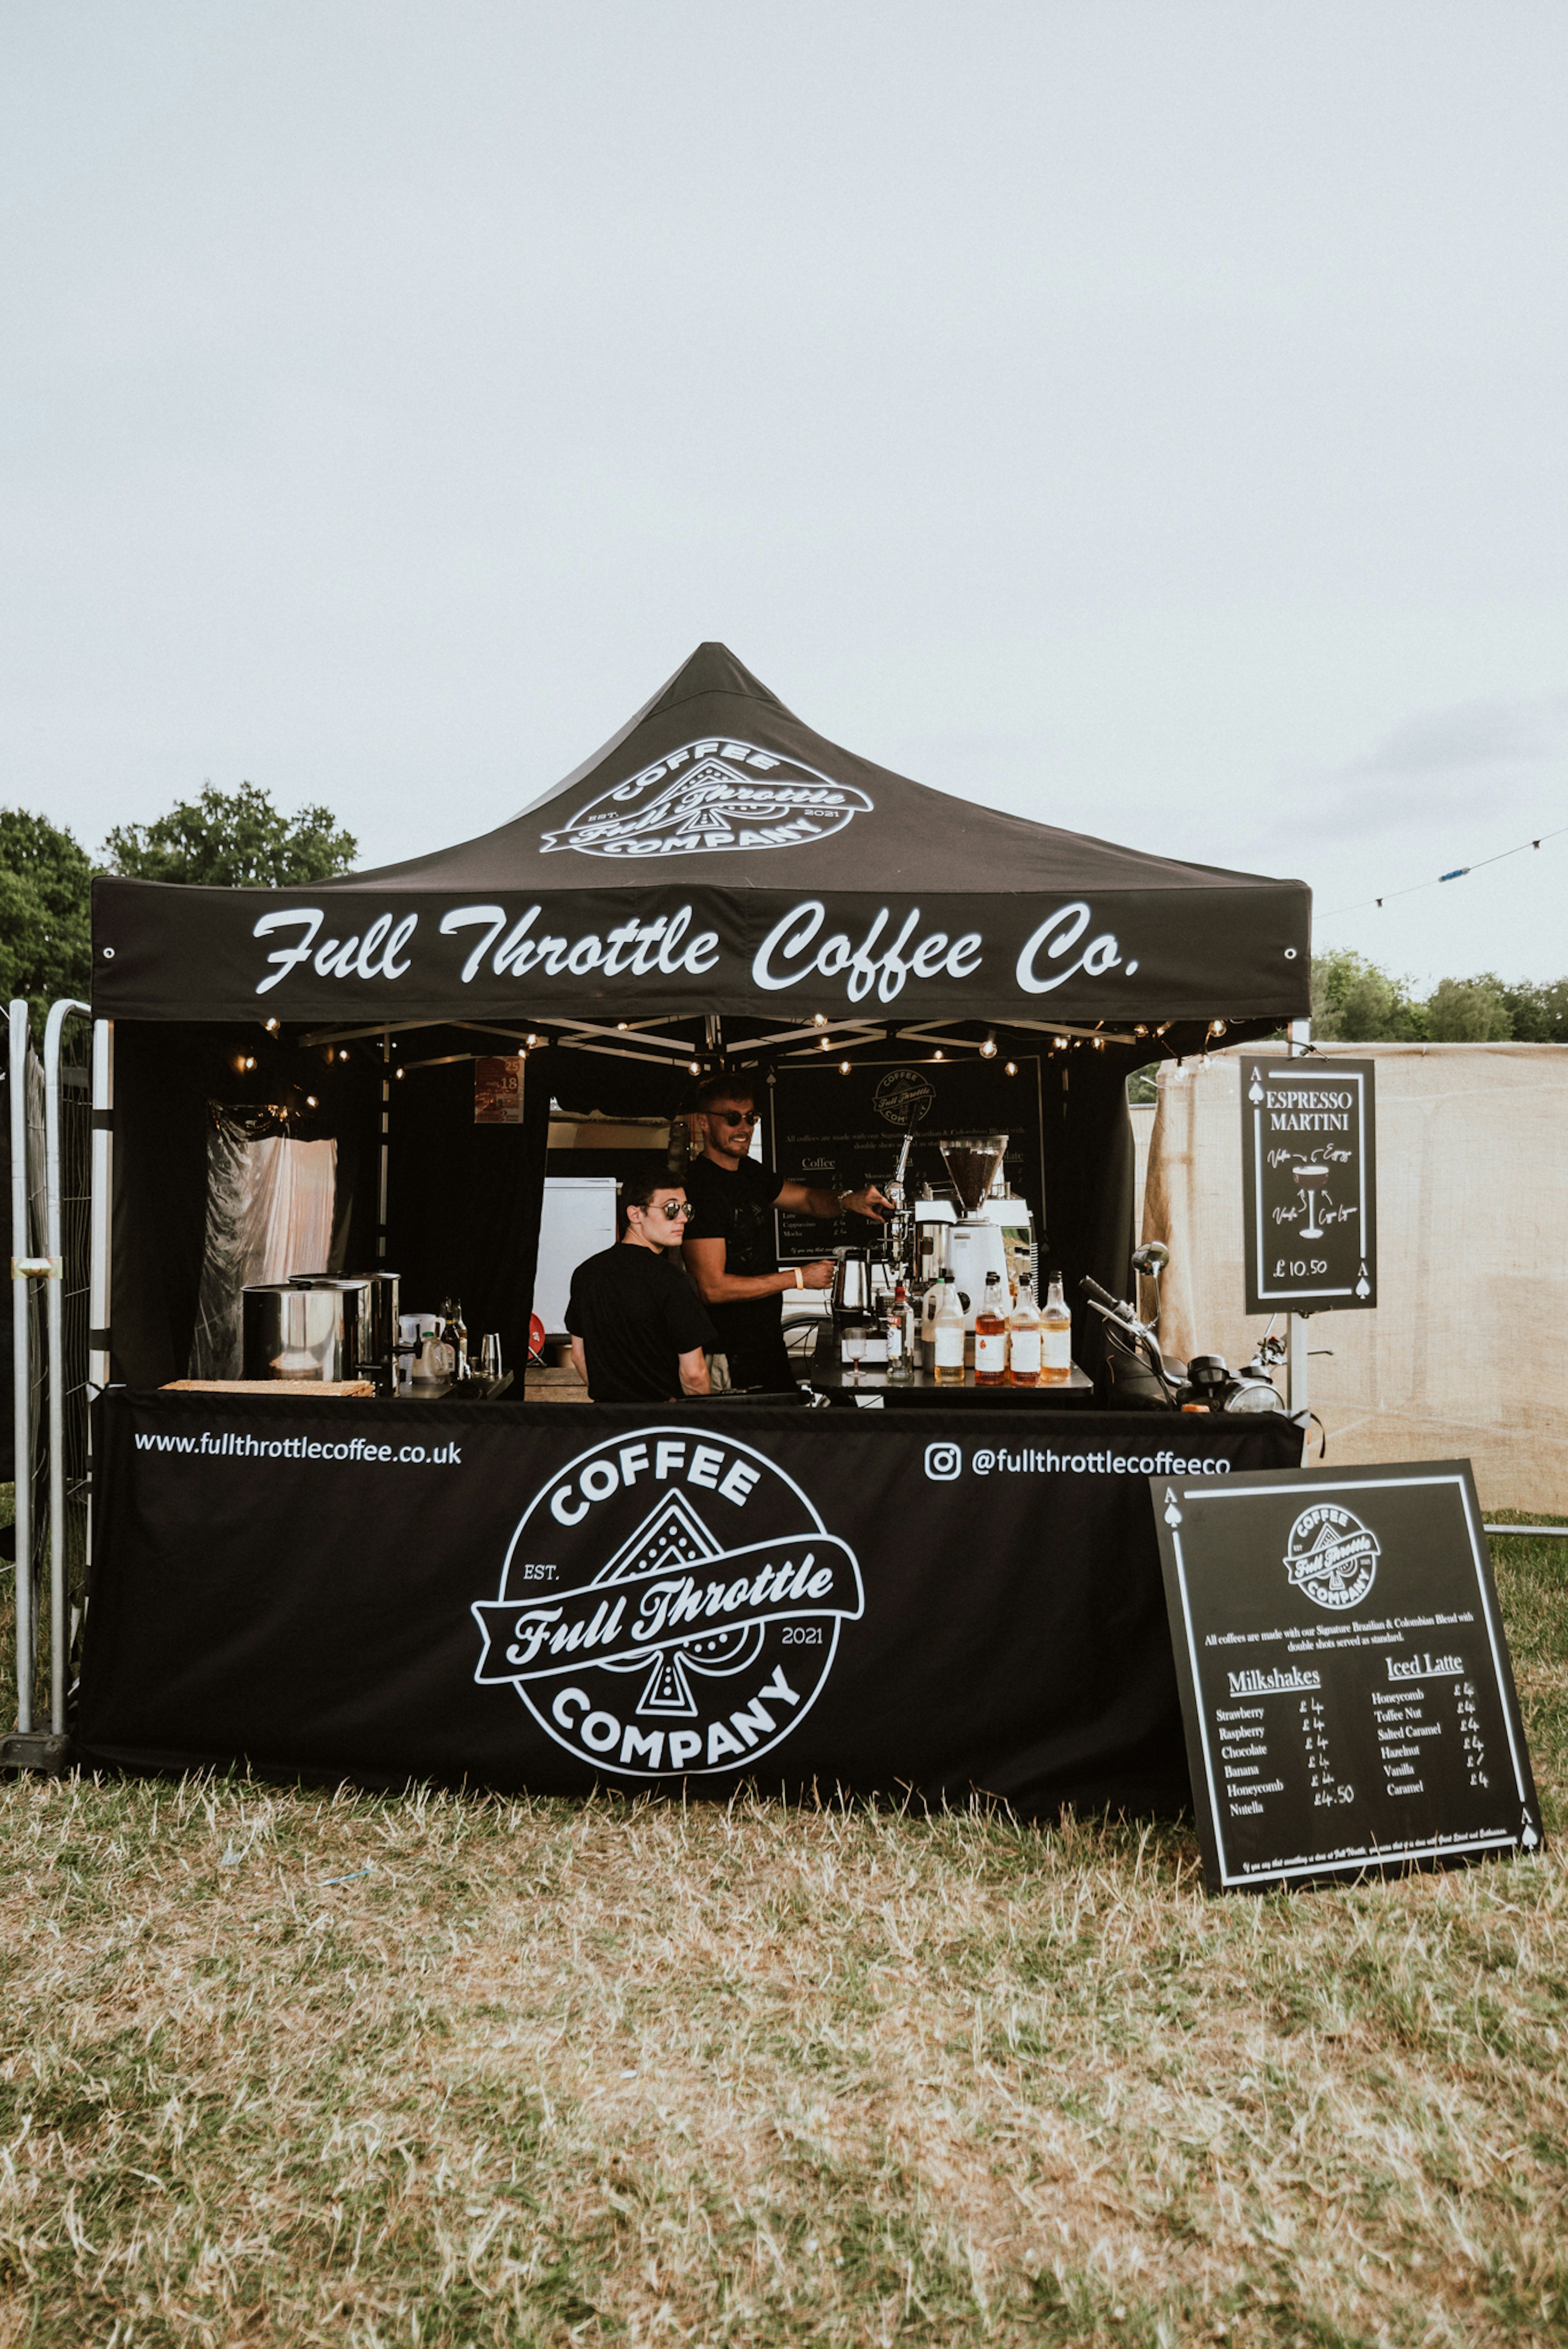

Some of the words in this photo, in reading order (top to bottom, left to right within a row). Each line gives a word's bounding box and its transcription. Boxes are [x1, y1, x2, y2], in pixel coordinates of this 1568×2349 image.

[612, 743, 780, 802] COFFEE
[569, 802, 672, 844] Full
[675, 784, 846, 813] Throttle
[588, 812, 619, 822] EST.
[804, 809, 840, 817] 2021
[604, 817, 822, 855] COMPANY
[253, 908, 418, 994] Full
[439, 906, 720, 984] Throttle
[751, 900, 982, 1003] Coffee
[1016, 902, 1139, 995] Co.
[883, 1072, 918, 1087] COFFEE
[1250, 1066, 1262, 1081] A
[501, 1078, 517, 1089] 18
[1266, 1091, 1352, 1109] ESPRESSO
[1270, 1113, 1349, 1131] MARTINI
[802, 1156, 836, 1168] Coffee
[1358, 1261, 1369, 1276] A
[134, 1432, 462, 1465] www.fullthrottlecoffee.co.uk
[972, 1448, 1231, 1475] @fullthrottlecoffeeco
[550, 1441, 761, 1526] COFFEE
[1164, 1486, 1178, 1503] A
[1297, 1509, 1348, 1537] COFFEE
[1294, 1554, 1323, 1579] Full
[1324, 1535, 1371, 1567] Throttle
[523, 1564, 559, 1581] EST.
[1307, 1567, 1370, 1605] COMPANY
[506, 1596, 627, 1665] Full
[630, 1553, 834, 1641] Throttle
[782, 1627, 823, 1644] 2021
[1205, 1634, 1217, 1646] All
[1218, 1632, 1246, 1645] coffees
[1247, 1633, 1259, 1642] are
[1261, 1628, 1282, 1641] made
[1283, 1627, 1301, 1639] with
[1301, 1628, 1316, 1637] our
[1316, 1624, 1351, 1637] Signature
[1352, 1620, 1385, 1633] Brazilian
[1386, 1618, 1393, 1630] &
[1394, 1616, 1434, 1628] Colombian
[1435, 1612, 1457, 1625] Blend
[1458, 1611, 1474, 1622] with
[1287, 1639, 1314, 1652] double
[1316, 1638, 1335, 1649] shots
[1336, 1635, 1360, 1648] served
[1361, 1637, 1370, 1645] as
[1385, 1654, 1421, 1677] Iced
[1423, 1653, 1463, 1673] Latte
[1227, 1665, 1321, 1693] Milkshakes
[1371, 1688, 1424, 1705] Honeycomb
[552, 1664, 800, 1769] COMPANY
[1216, 1707, 1264, 1722] Strawberry
[1374, 1709, 1403, 1723] Toffee
[1405, 1707, 1422, 1720] Nut
[1218, 1726, 1265, 1742] Raspberry
[1377, 1726, 1405, 1741] Salted
[1405, 1722, 1441, 1738] Caramel
[1221, 1743, 1267, 1759] Chocolate
[1381, 1744, 1421, 1759] Hazelnut
[1224, 1765, 1260, 1779] Banana
[1383, 1762, 1415, 1777] Vanilla
[1227, 1778, 1284, 1798] Honeycomb
[1387, 1779, 1424, 1797] Caramel
[1229, 1800, 1264, 1817] Nutella
[1521, 1806, 1532, 1824] A
